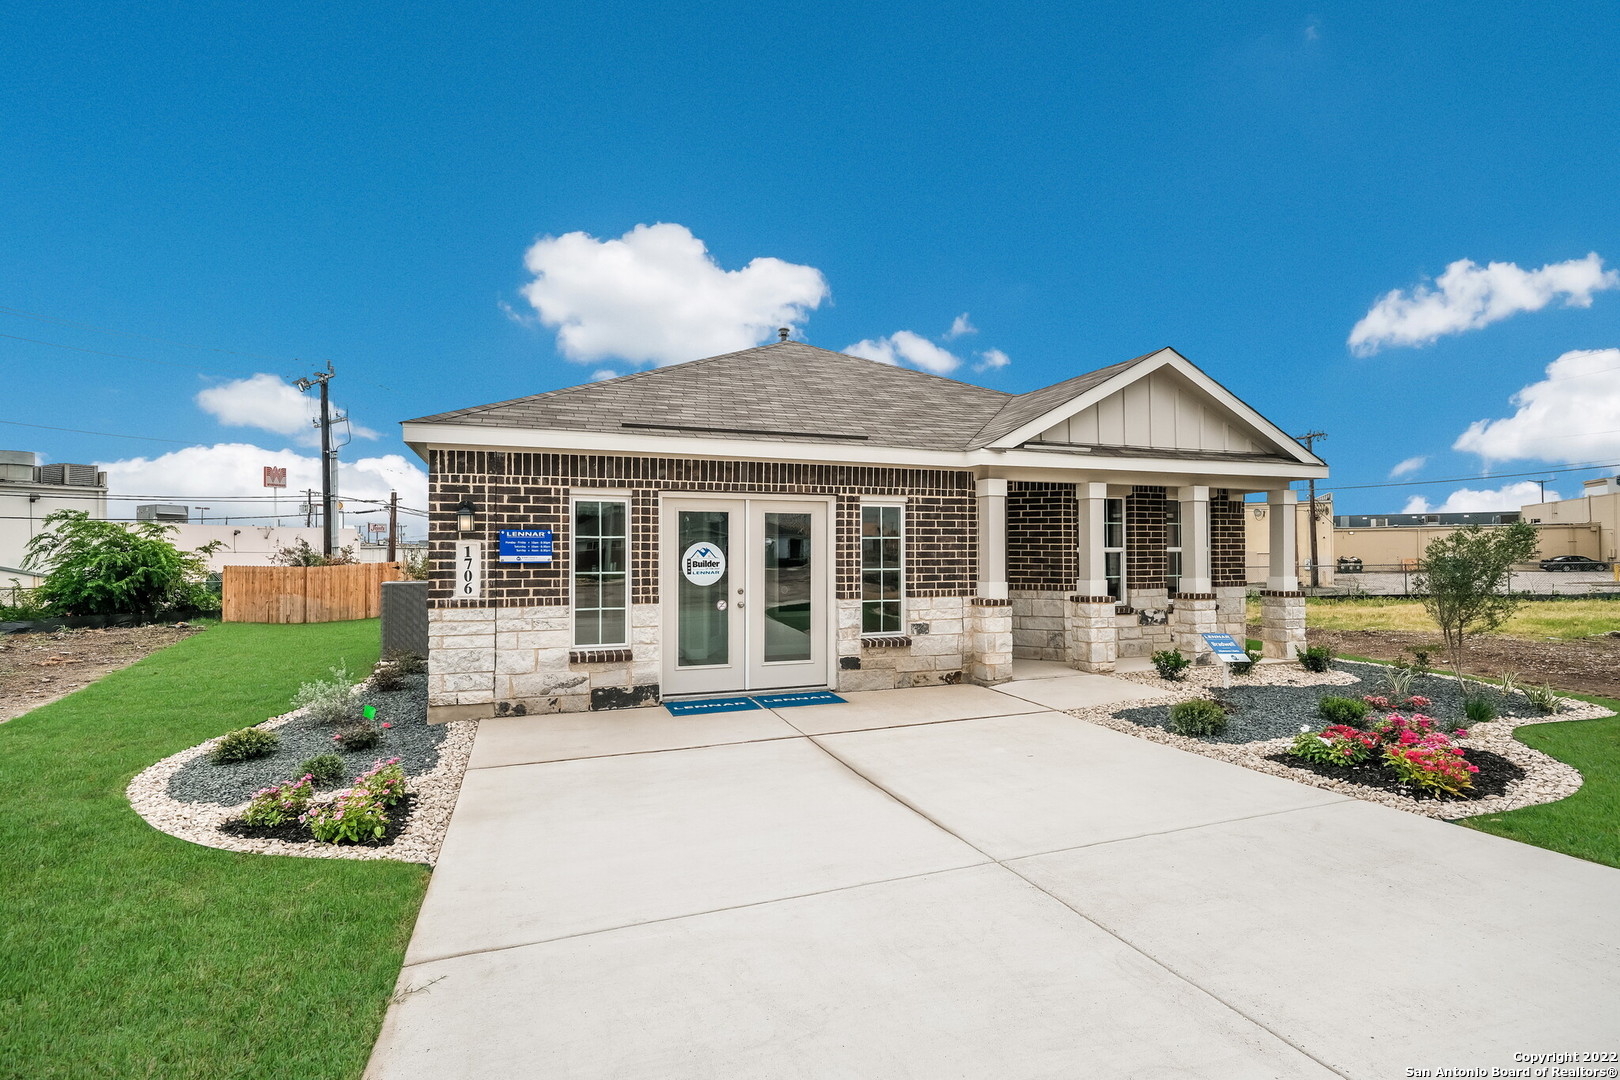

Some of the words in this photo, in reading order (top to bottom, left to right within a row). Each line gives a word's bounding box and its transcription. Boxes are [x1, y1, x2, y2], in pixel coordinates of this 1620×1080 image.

[692, 560, 720, 568] Builder
[464, 546, 472, 594] 1706
[763, 695, 832, 703] LENNAR
[673, 702, 746, 710] LENNAR
